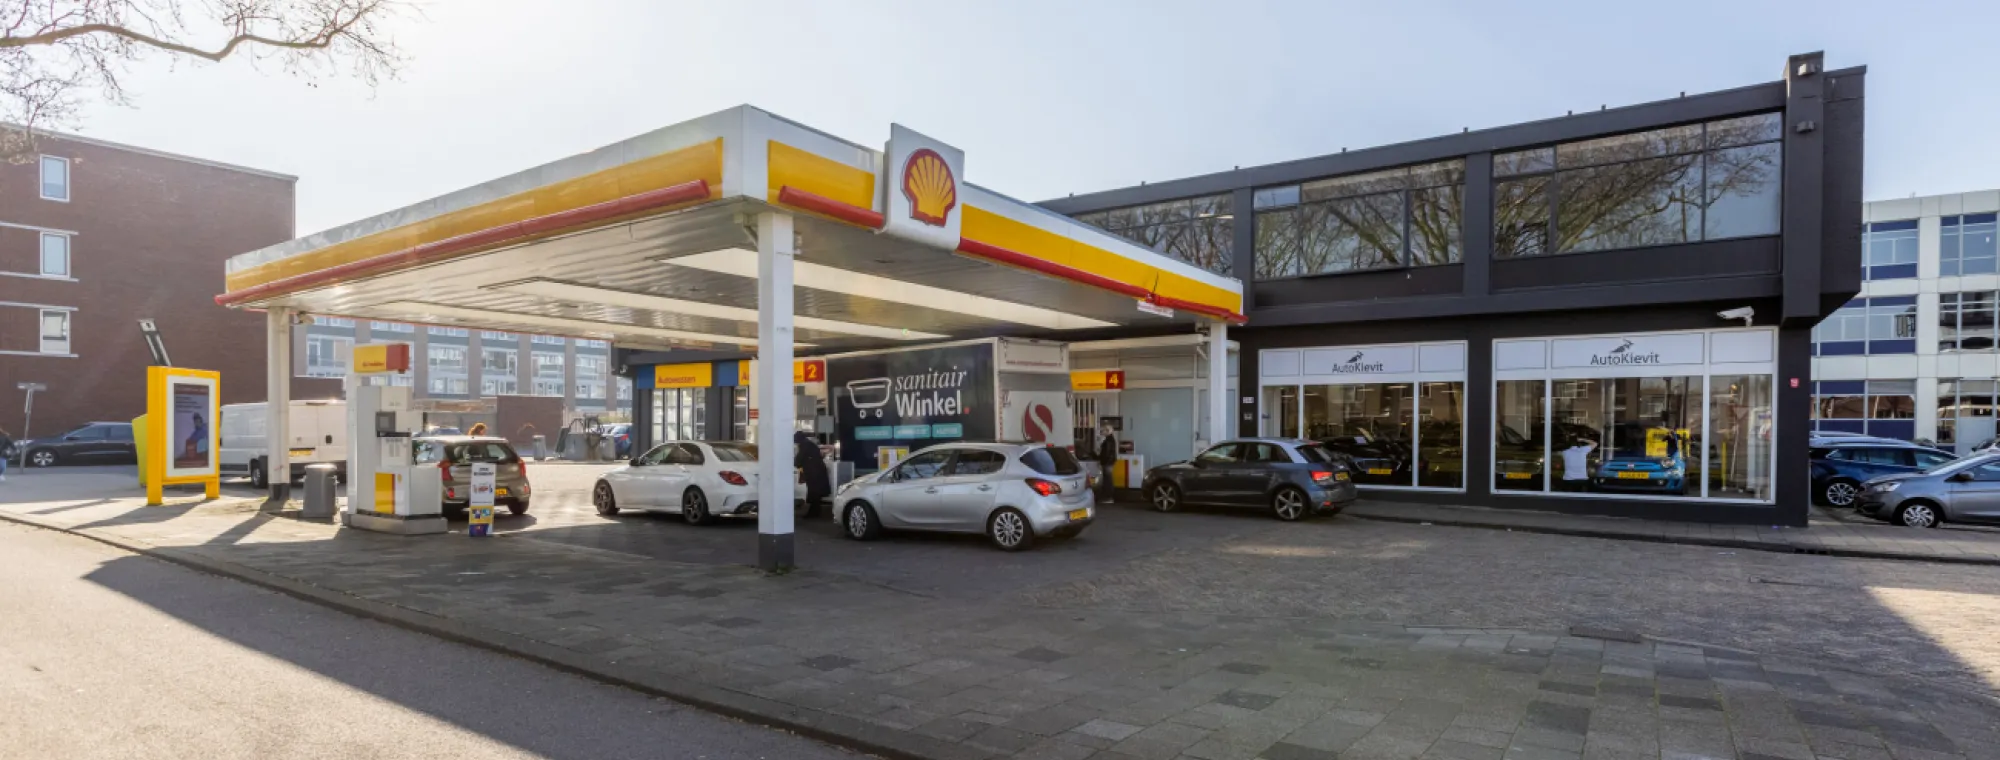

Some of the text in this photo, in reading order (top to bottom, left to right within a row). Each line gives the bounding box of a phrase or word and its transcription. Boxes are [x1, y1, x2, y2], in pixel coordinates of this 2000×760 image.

[1590, 352, 1660, 366] AutoKievit
[807, 363, 817, 379] 2
[1332, 361, 1384, 374] AutoKievit
[895, 366, 967, 391] sanitair
[1108, 373, 1120, 387] 4
